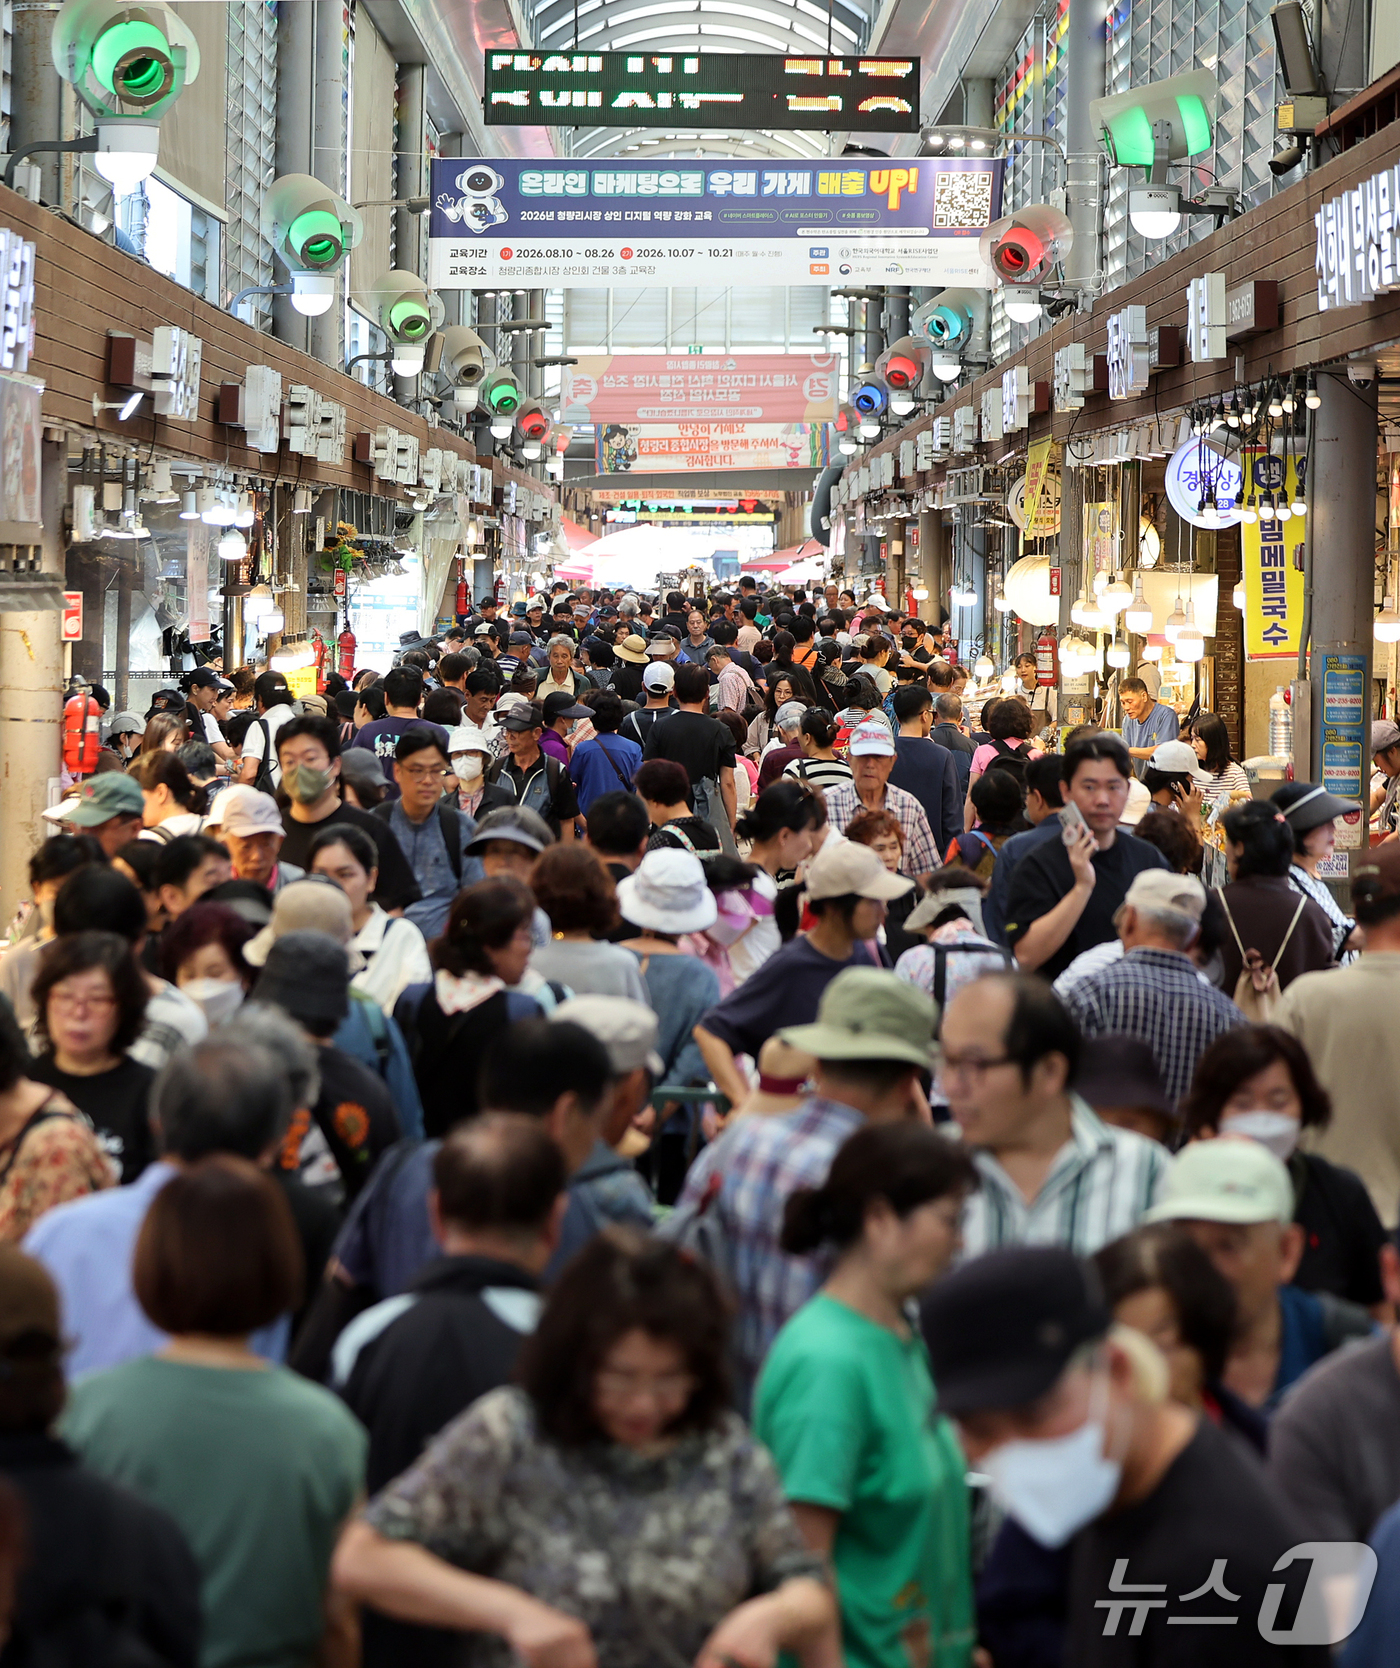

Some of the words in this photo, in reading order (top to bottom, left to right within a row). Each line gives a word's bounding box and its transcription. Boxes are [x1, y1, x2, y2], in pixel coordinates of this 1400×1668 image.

[520, 171, 588, 195] 온라인
[593, 171, 703, 195] 마케팅으로
[708, 171, 757, 195] 우리
[763, 171, 810, 195] 가게
[818, 170, 864, 195] 매출
[869, 167, 919, 211] UP!
[520, 210, 555, 221] 2026년
[557, 210, 602, 221] 청량리시장
[604, 210, 622, 221] 상인
[624, 210, 652, 221] 디지털
[653, 210, 672, 221] 역량
[674, 210, 692, 221] 강화
[694, 210, 713, 221] 교육
[449, 248, 488, 258] 교육기간
[516, 248, 573, 258] 2026.08.10
[584, 248, 615, 258] 08.26
[707, 249, 734, 258] 10.21
[449, 266, 488, 276] 교육장소
[498, 266, 560, 276] 청량리종합시장
[562, 266, 590, 276] 상인회
[592, 266, 610, 276] 건물
[612, 265, 627, 275] 3층
[629, 265, 656, 275] 교육장
[677, 423, 711, 436] 안녕히
[720, 438, 749, 450] 방문해
[686, 454, 736, 467] 감사합니다.
[1258, 494, 1289, 646] 빔메밀국수
